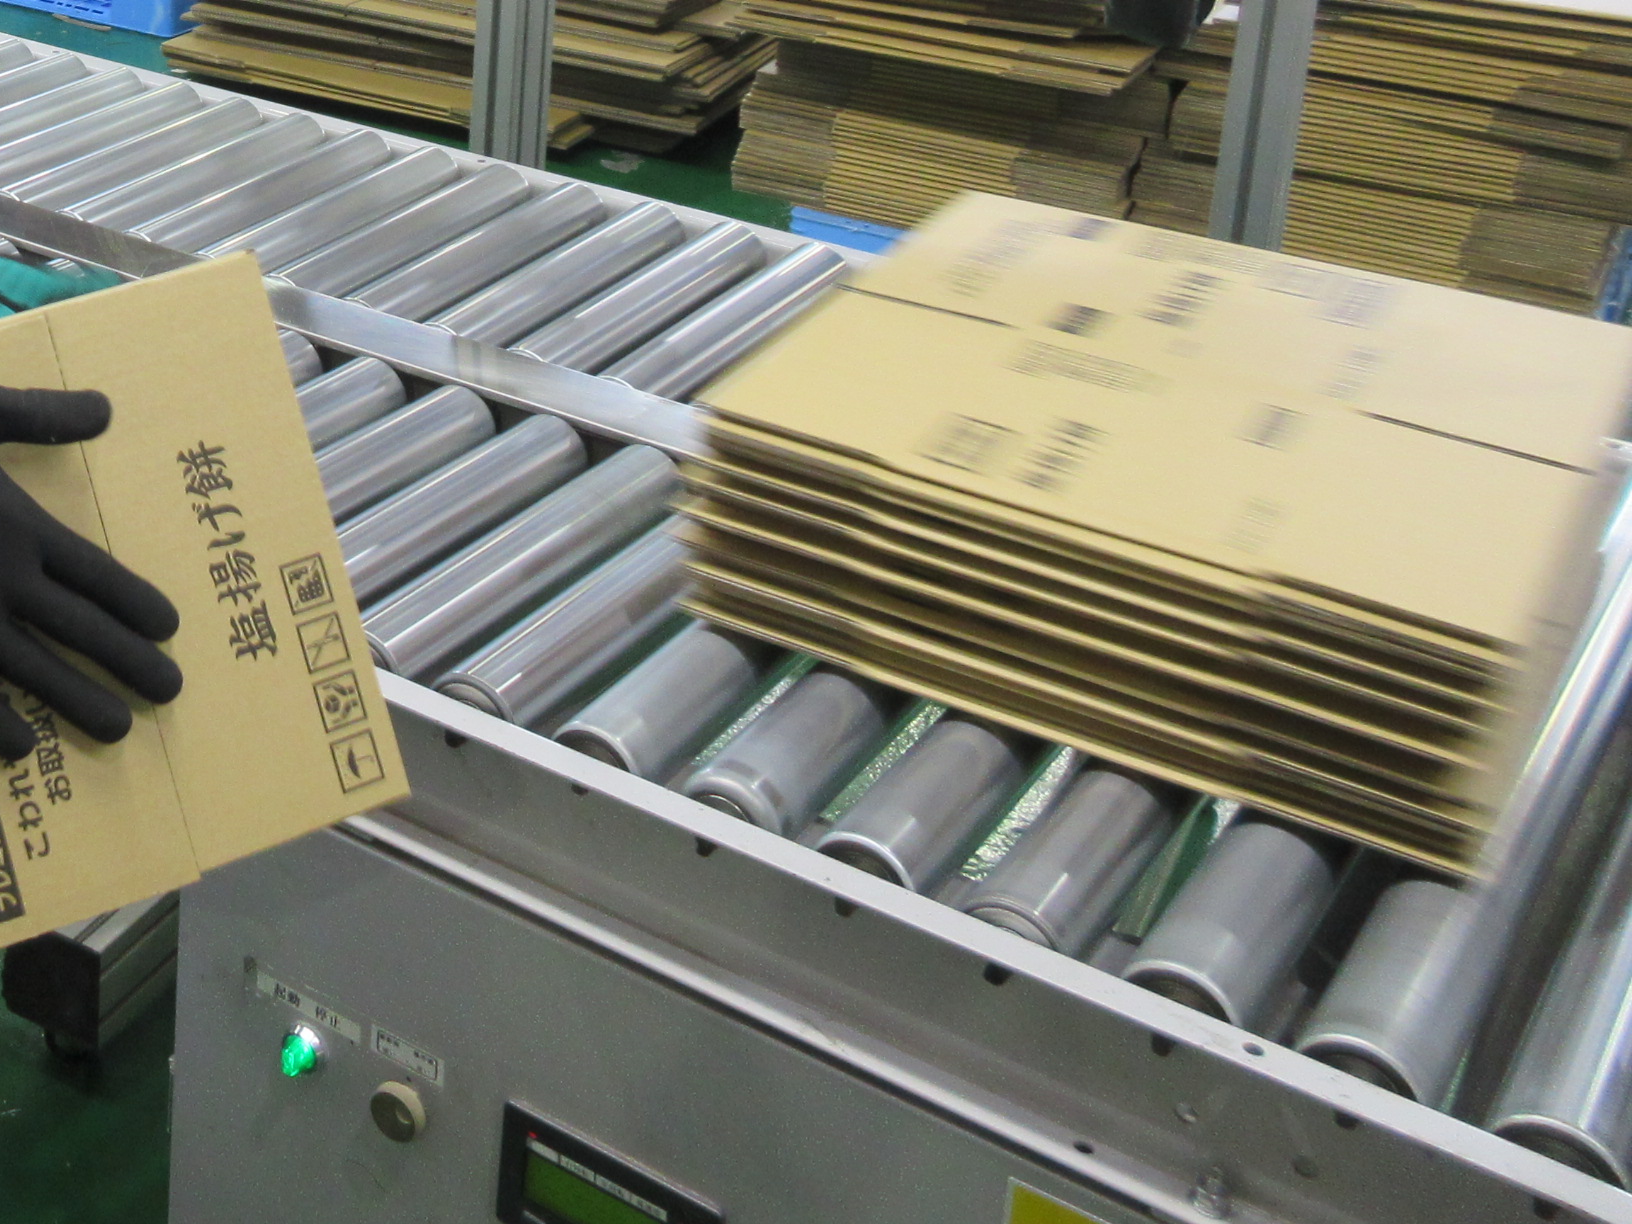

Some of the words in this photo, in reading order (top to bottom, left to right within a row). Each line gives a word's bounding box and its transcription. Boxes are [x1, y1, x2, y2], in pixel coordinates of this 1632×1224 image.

[176, 439, 278, 662] 塩揚げ餅
[1, 754, 51, 861] こわれ
